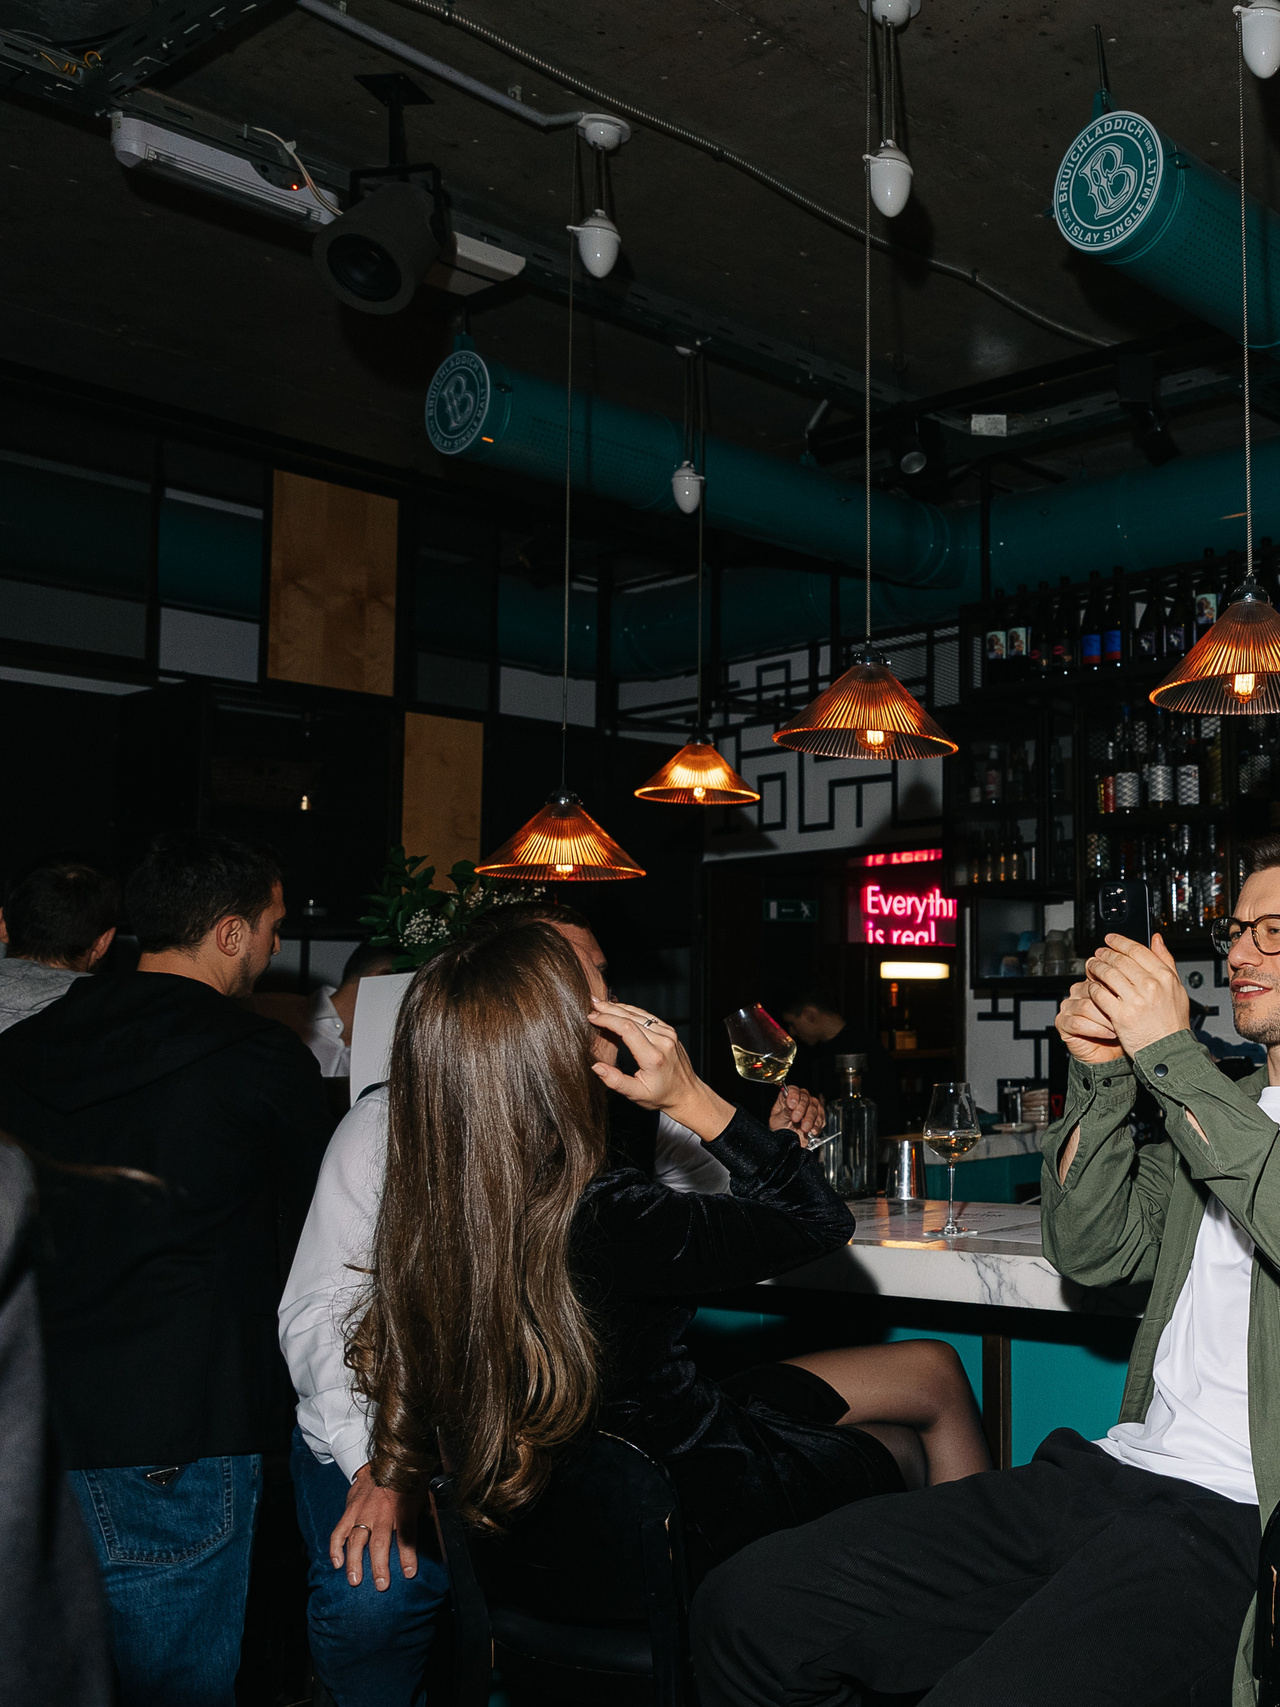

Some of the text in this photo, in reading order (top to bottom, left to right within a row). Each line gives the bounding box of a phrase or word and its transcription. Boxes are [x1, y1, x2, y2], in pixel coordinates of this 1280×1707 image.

[1059, 119, 1145, 203] BRUICHLADDICH
[1068, 158, 1157, 243] ISLAY SINGLE MALT
[867, 885, 957, 924] Everythi
[867, 920, 936, 945] is real
